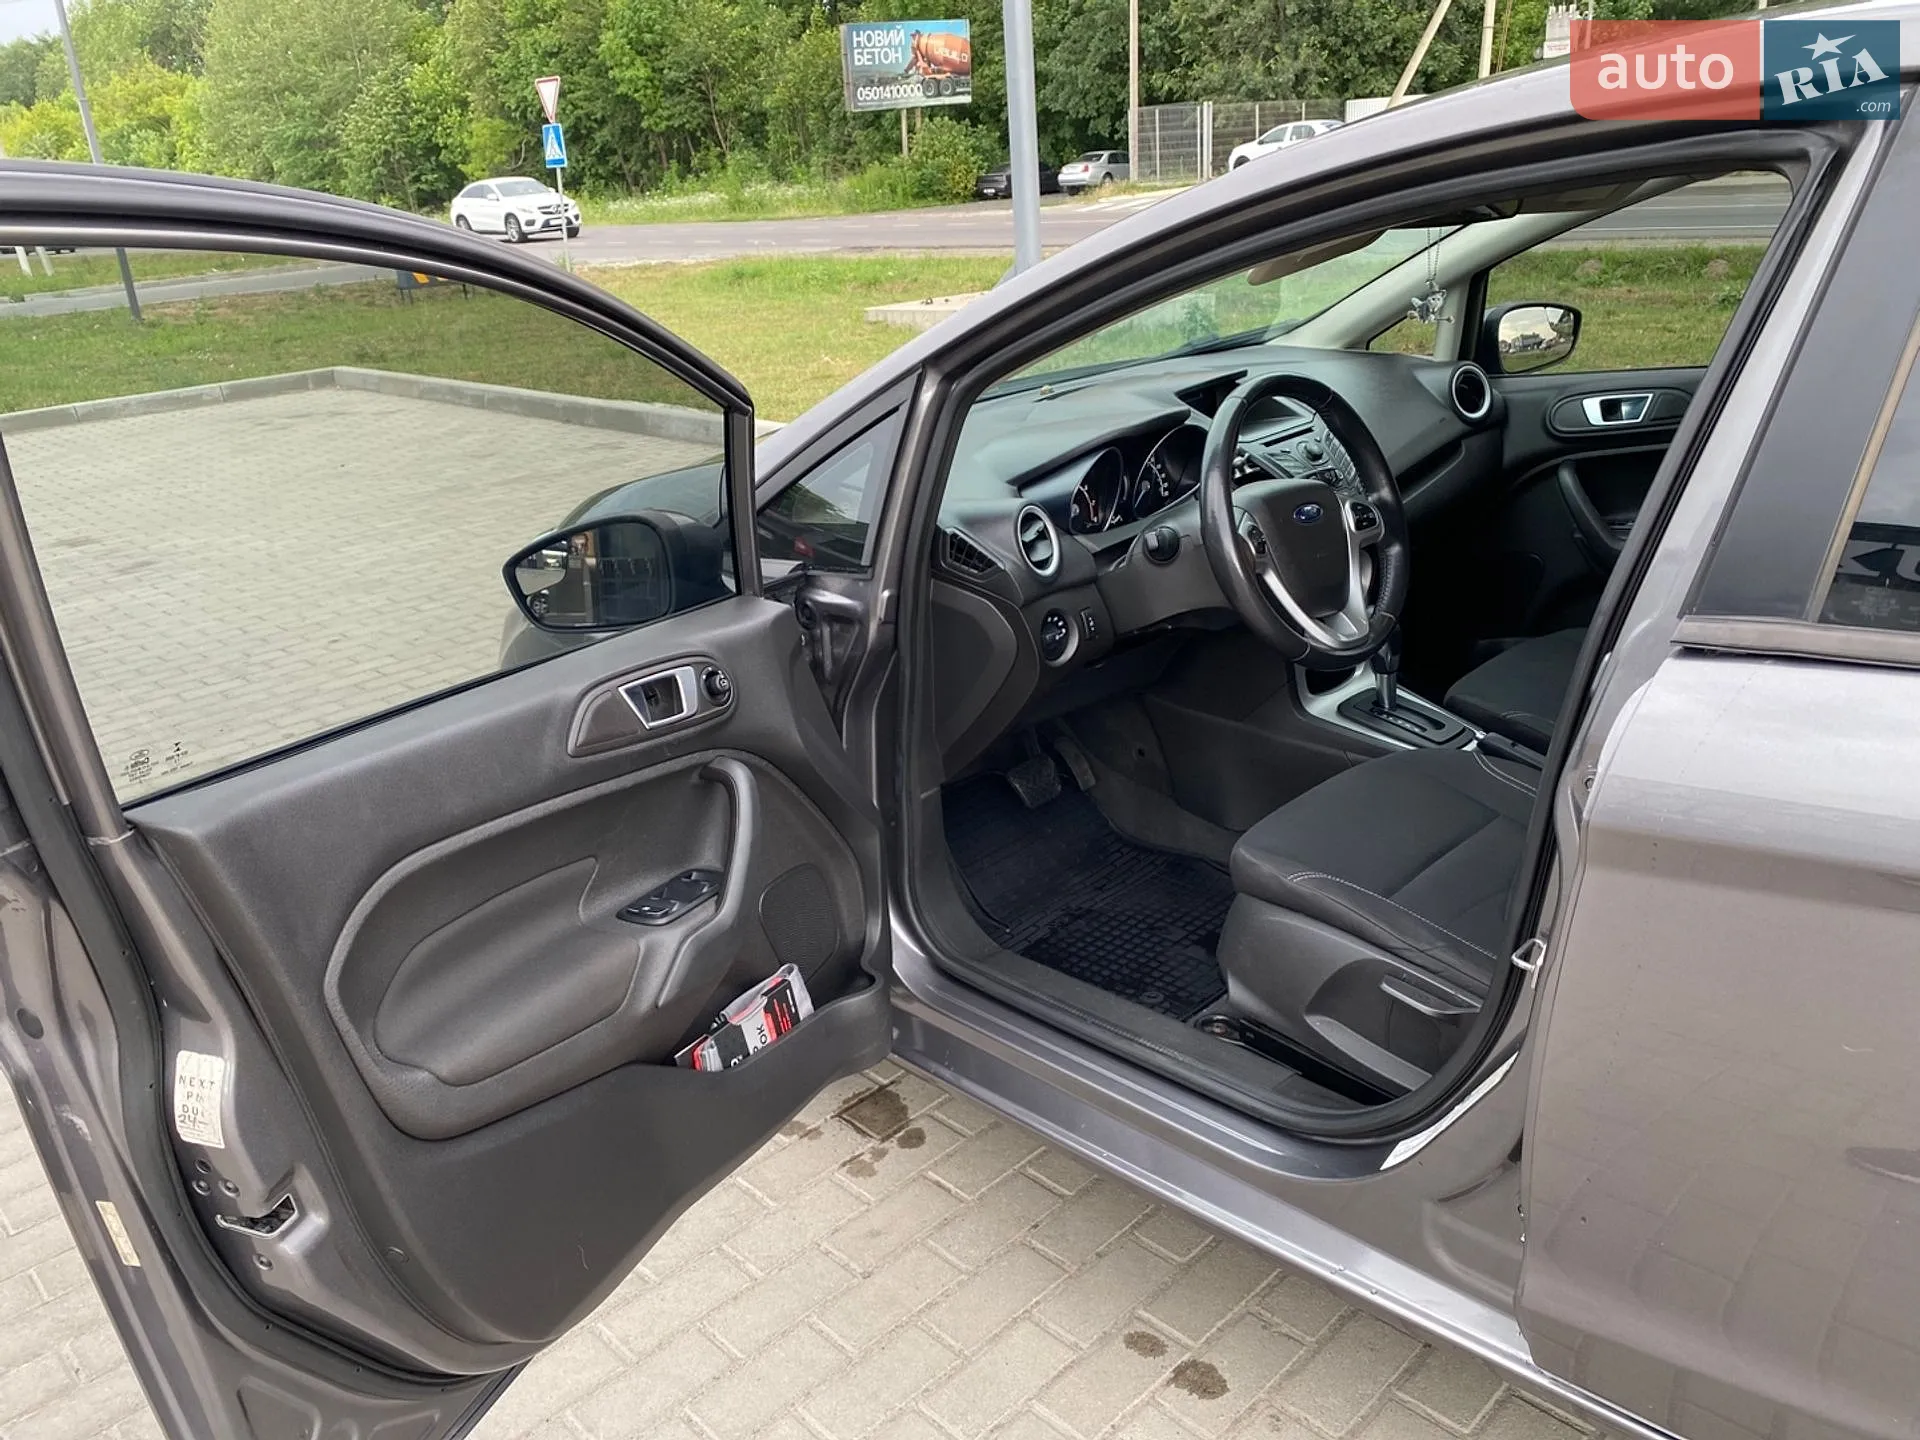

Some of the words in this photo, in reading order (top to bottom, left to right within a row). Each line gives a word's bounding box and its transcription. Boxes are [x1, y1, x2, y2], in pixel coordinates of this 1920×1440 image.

[853, 25, 905, 48] НОВИЙ
[854, 47, 902, 66] БЕТОН
[857, 84, 923, 101] 0501410000
[178, 1074, 216, 1090] NEXT
